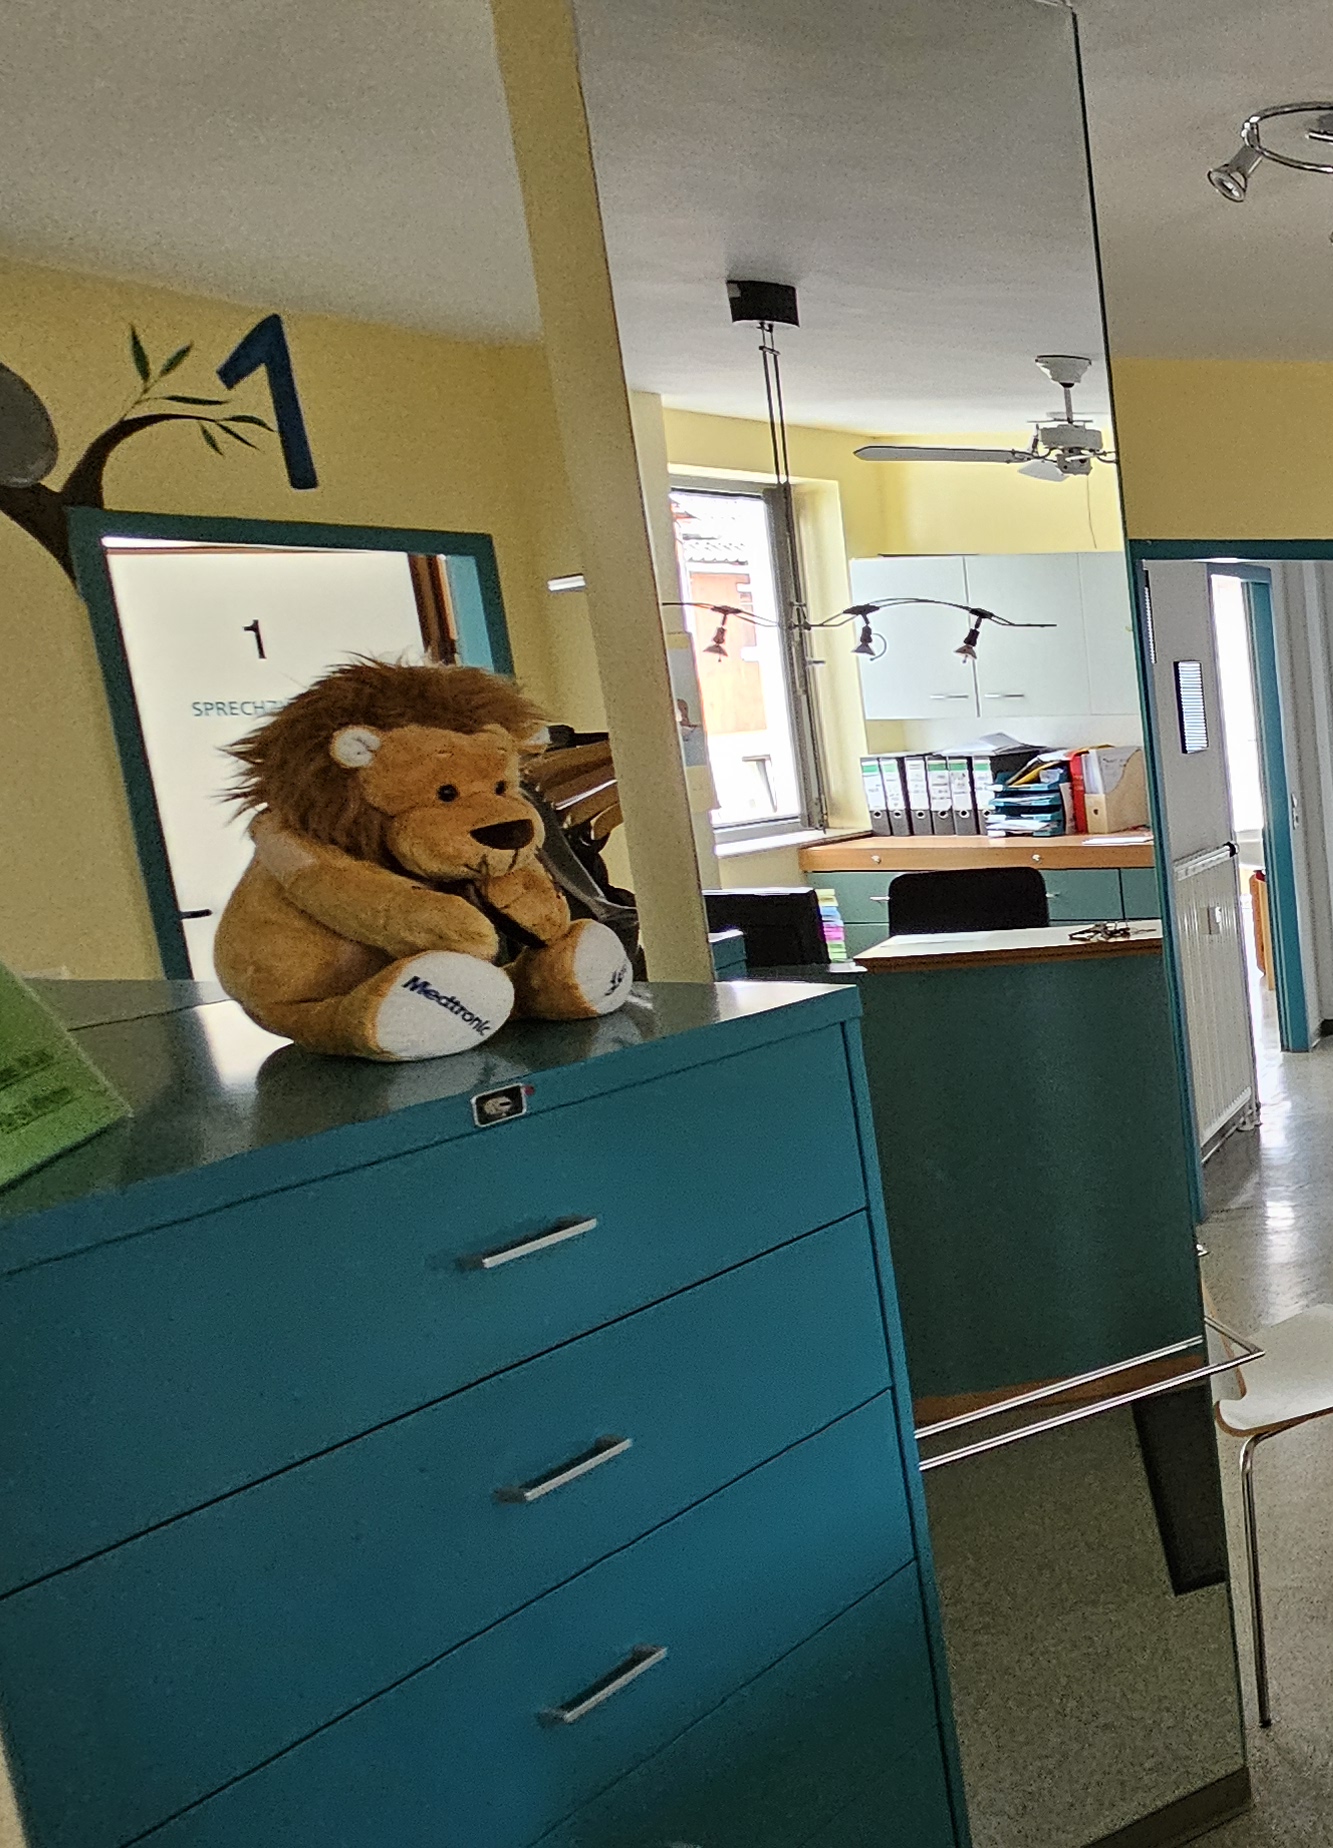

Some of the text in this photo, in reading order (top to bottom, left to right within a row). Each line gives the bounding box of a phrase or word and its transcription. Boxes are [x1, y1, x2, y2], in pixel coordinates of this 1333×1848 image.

[217, 313, 319, 490] 1
[242, 619, 267, 660] 1
[192, 699, 288, 717] SPRECH
